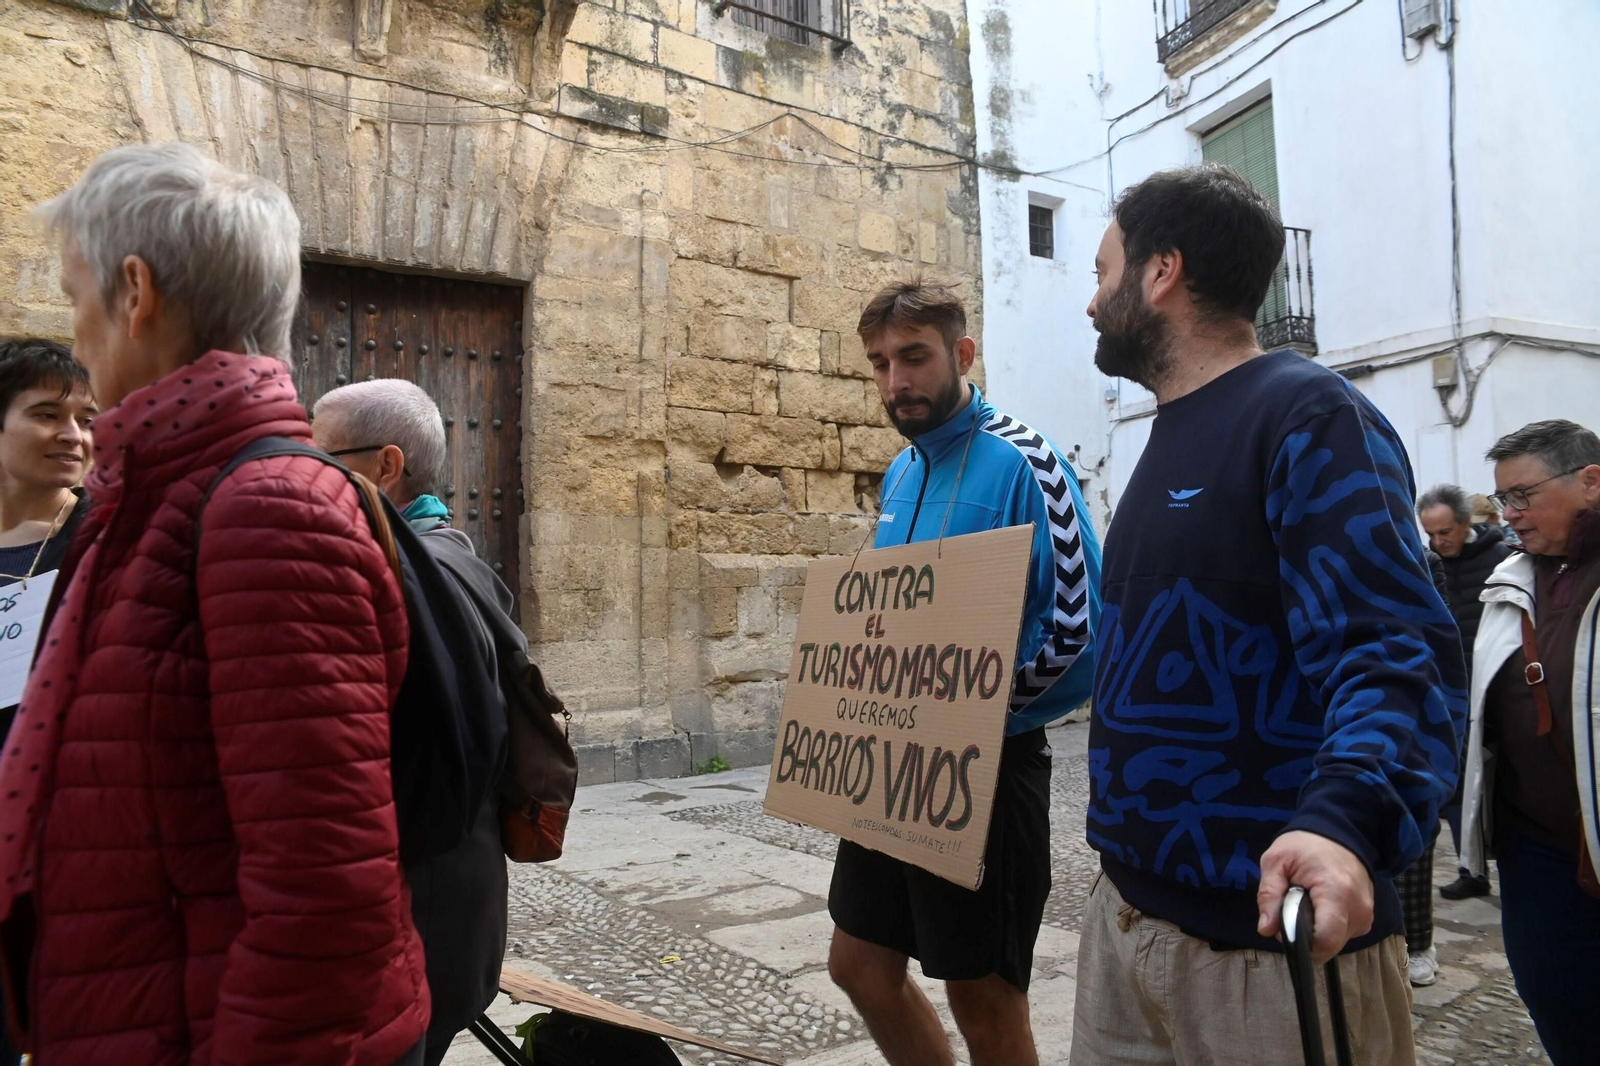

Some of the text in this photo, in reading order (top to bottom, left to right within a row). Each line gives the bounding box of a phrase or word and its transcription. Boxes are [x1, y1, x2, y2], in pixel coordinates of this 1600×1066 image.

[834, 564, 934, 614] CONTRA
[865, 613, 885, 639] EL
[798, 642, 1003, 702] TURISMO MASIVO
[836, 697, 918, 730] QUEREMOS
[776, 719, 980, 832] BARRIOS VIVOS
